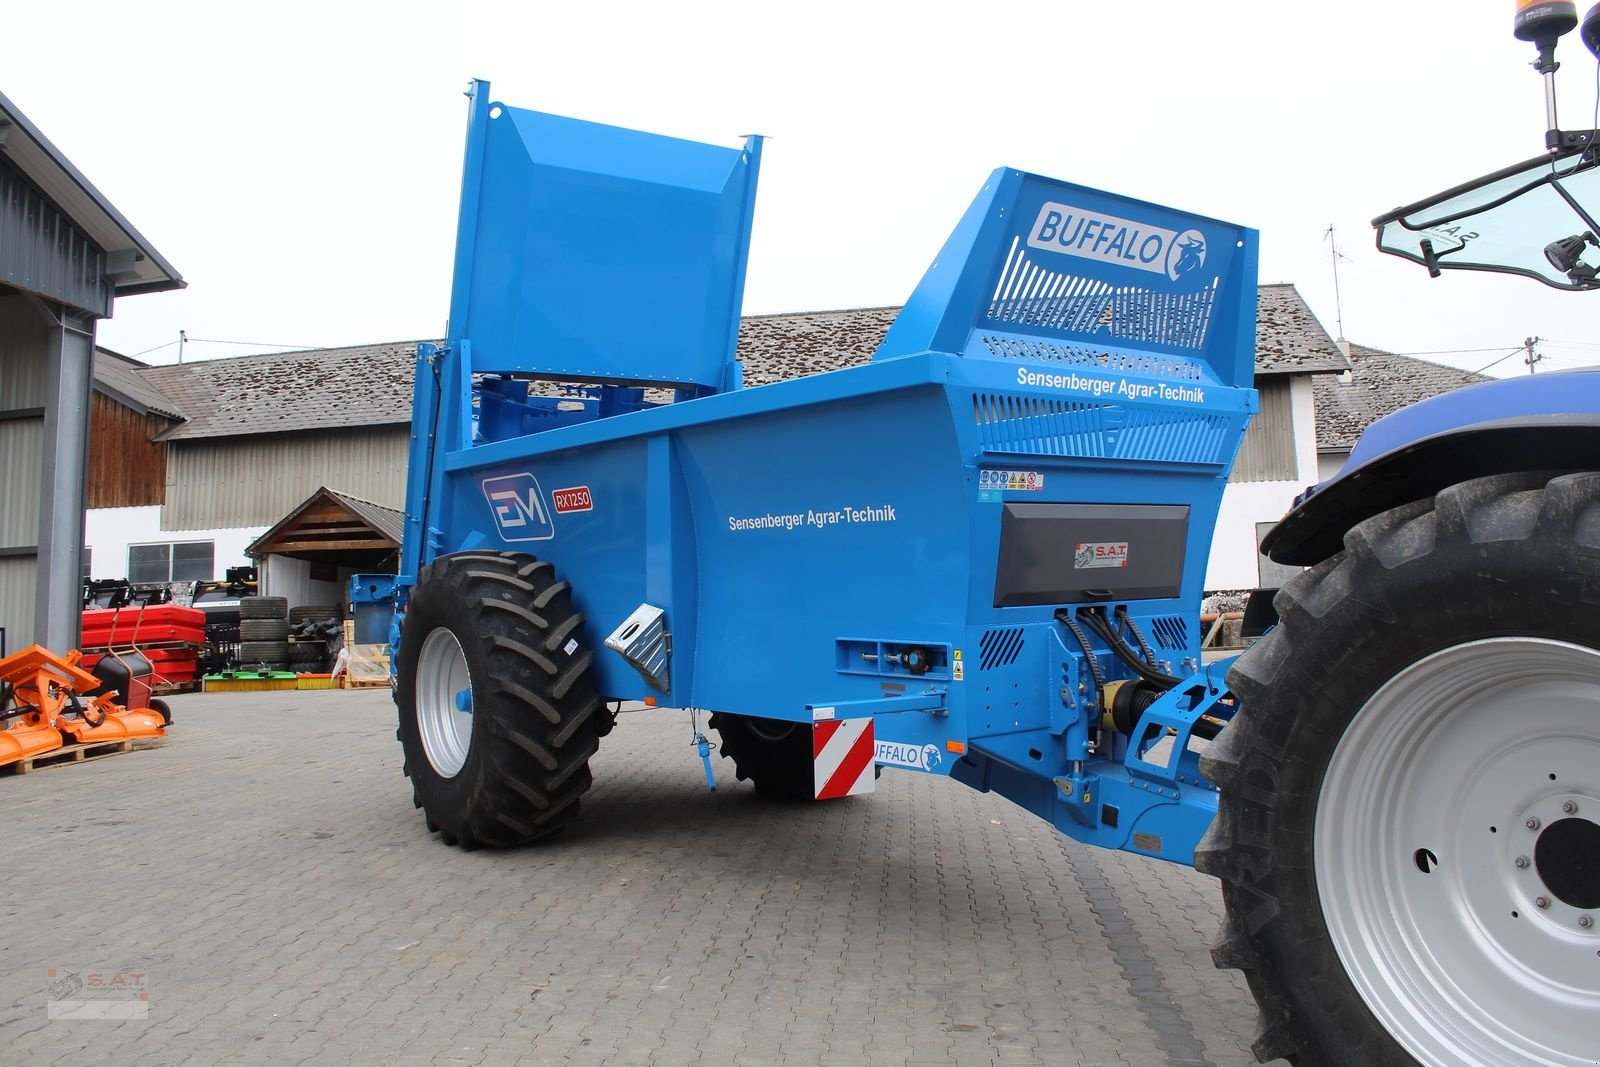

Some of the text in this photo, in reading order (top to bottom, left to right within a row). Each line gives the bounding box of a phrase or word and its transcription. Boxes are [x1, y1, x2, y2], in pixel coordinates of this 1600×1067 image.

[1037, 210, 1163, 263] BUFFALO
[1017, 367, 1204, 403] Sensenberger Agrar-Technik
[555, 491, 590, 509] RX1250
[728, 505, 896, 531] Sensenberger Agrar-Technik
[875, 743, 918, 764] UFFALO
